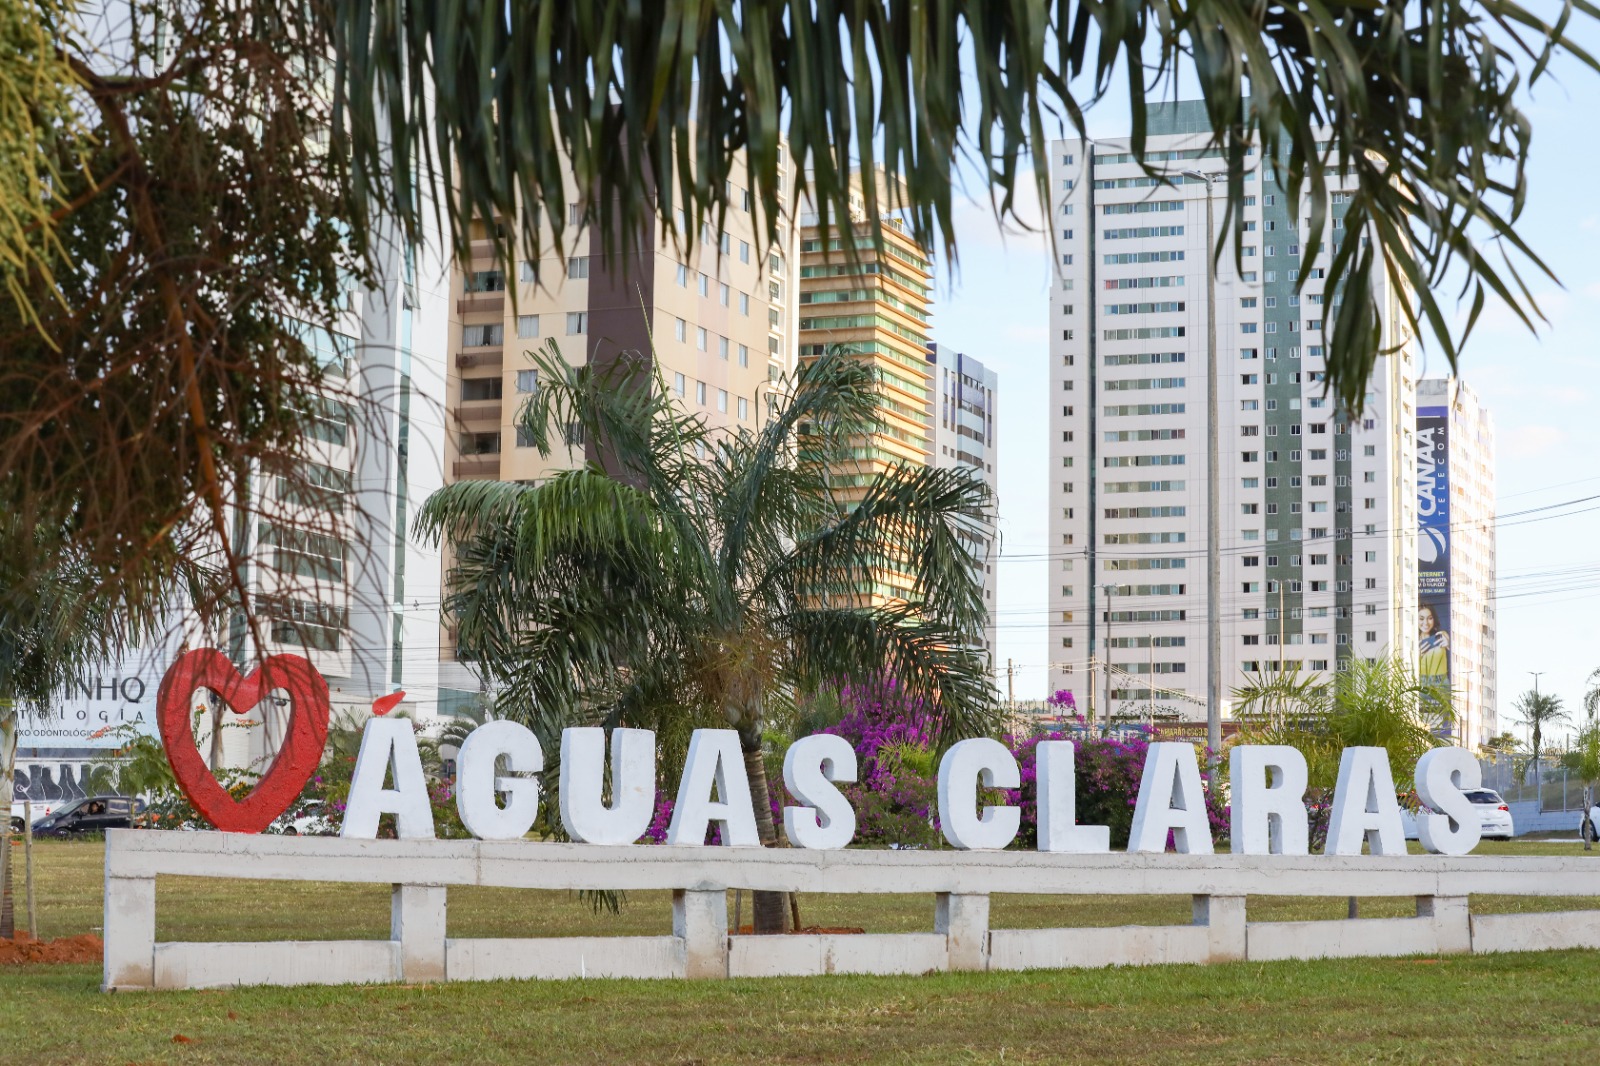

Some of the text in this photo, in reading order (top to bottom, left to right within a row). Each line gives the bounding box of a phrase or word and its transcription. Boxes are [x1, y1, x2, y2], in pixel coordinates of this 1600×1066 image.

[1437, 427, 1446, 516] TELECOM
[341, 690, 1482, 856] ÁGUAS CLARAS
